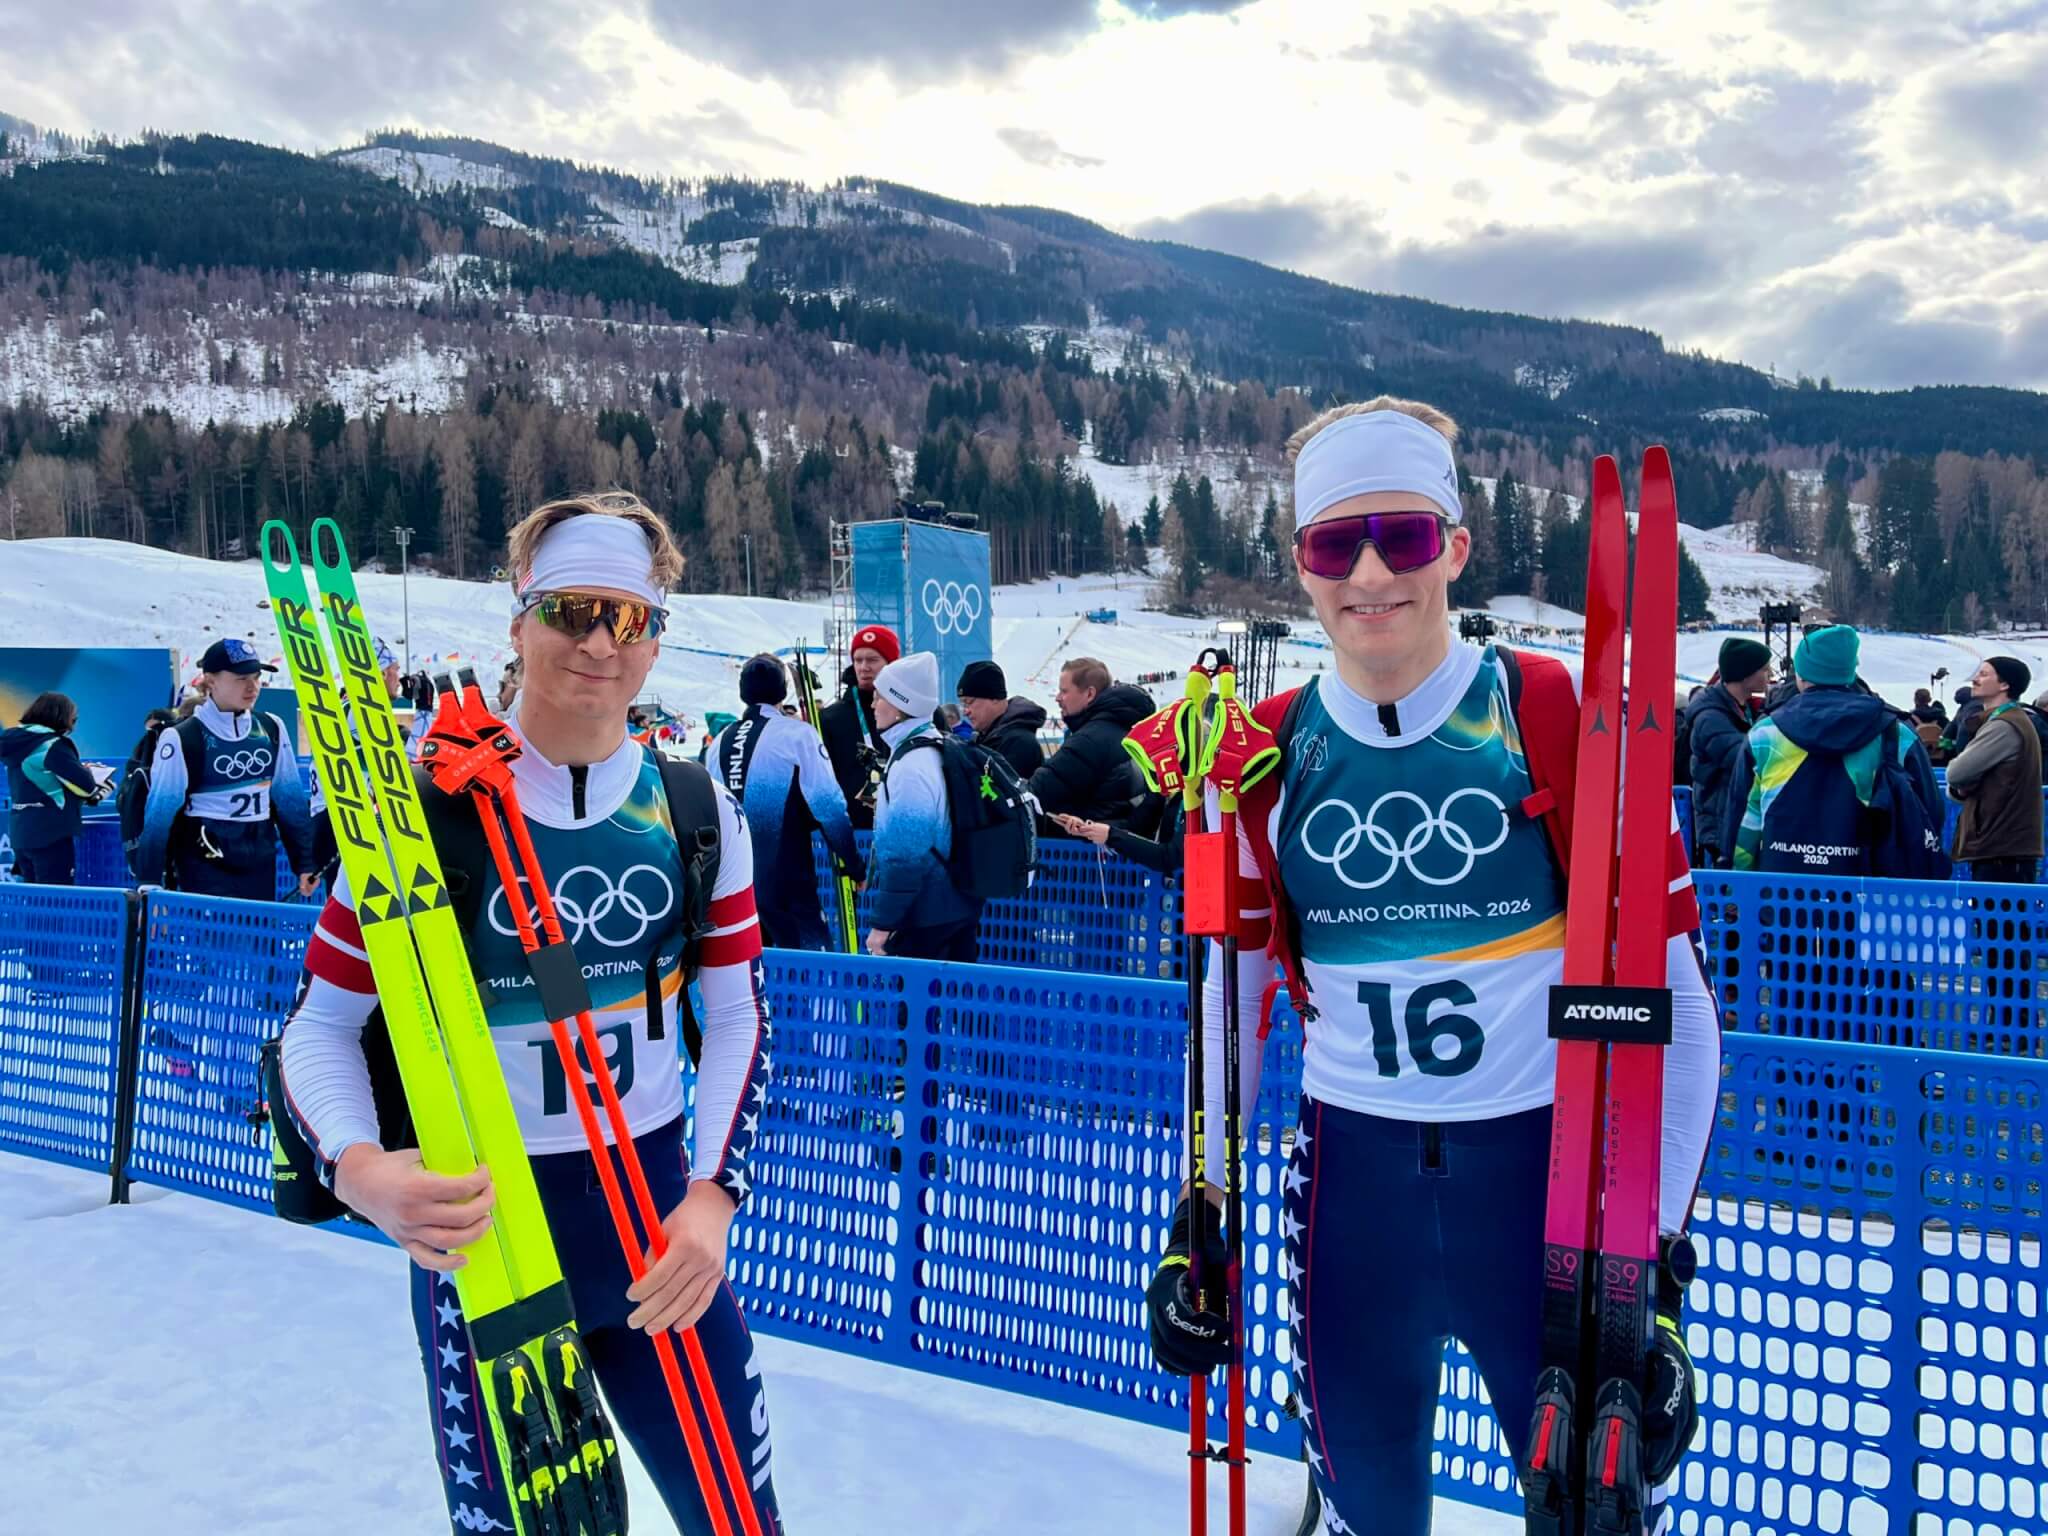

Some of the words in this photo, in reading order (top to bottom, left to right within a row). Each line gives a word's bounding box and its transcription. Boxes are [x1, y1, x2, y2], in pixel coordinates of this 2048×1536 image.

[280, 597, 376, 851] FISCHER
[329, 592, 424, 841] FISCHER
[1227, 703, 1247, 746] LEKI
[729, 720, 753, 790] FINLAND
[1160, 757, 1180, 793] LE
[230, 792, 261, 818] 21
[1769, 841, 1815, 854] MILANO
[1817, 846, 1859, 856] CORTIN
[1803, 854, 1829, 865] 2026
[1306, 906, 1379, 924] MILANO
[1383, 903, 1481, 921] CORTINA
[1487, 898, 1532, 917] 2026
[488, 975, 536, 988] MILA
[581, 960, 643, 979] ORTINA
[1357, 979, 1485, 1078] 16
[1564, 1005, 1651, 1022] ATOMIC
[527, 1021, 635, 1116] 19
[1194, 1110, 1206, 1188] LEKI
[1609, 1100, 1622, 1188] REDSTER
[1547, 1249, 1578, 1275] S9
[1605, 1260, 1639, 1287] S9
